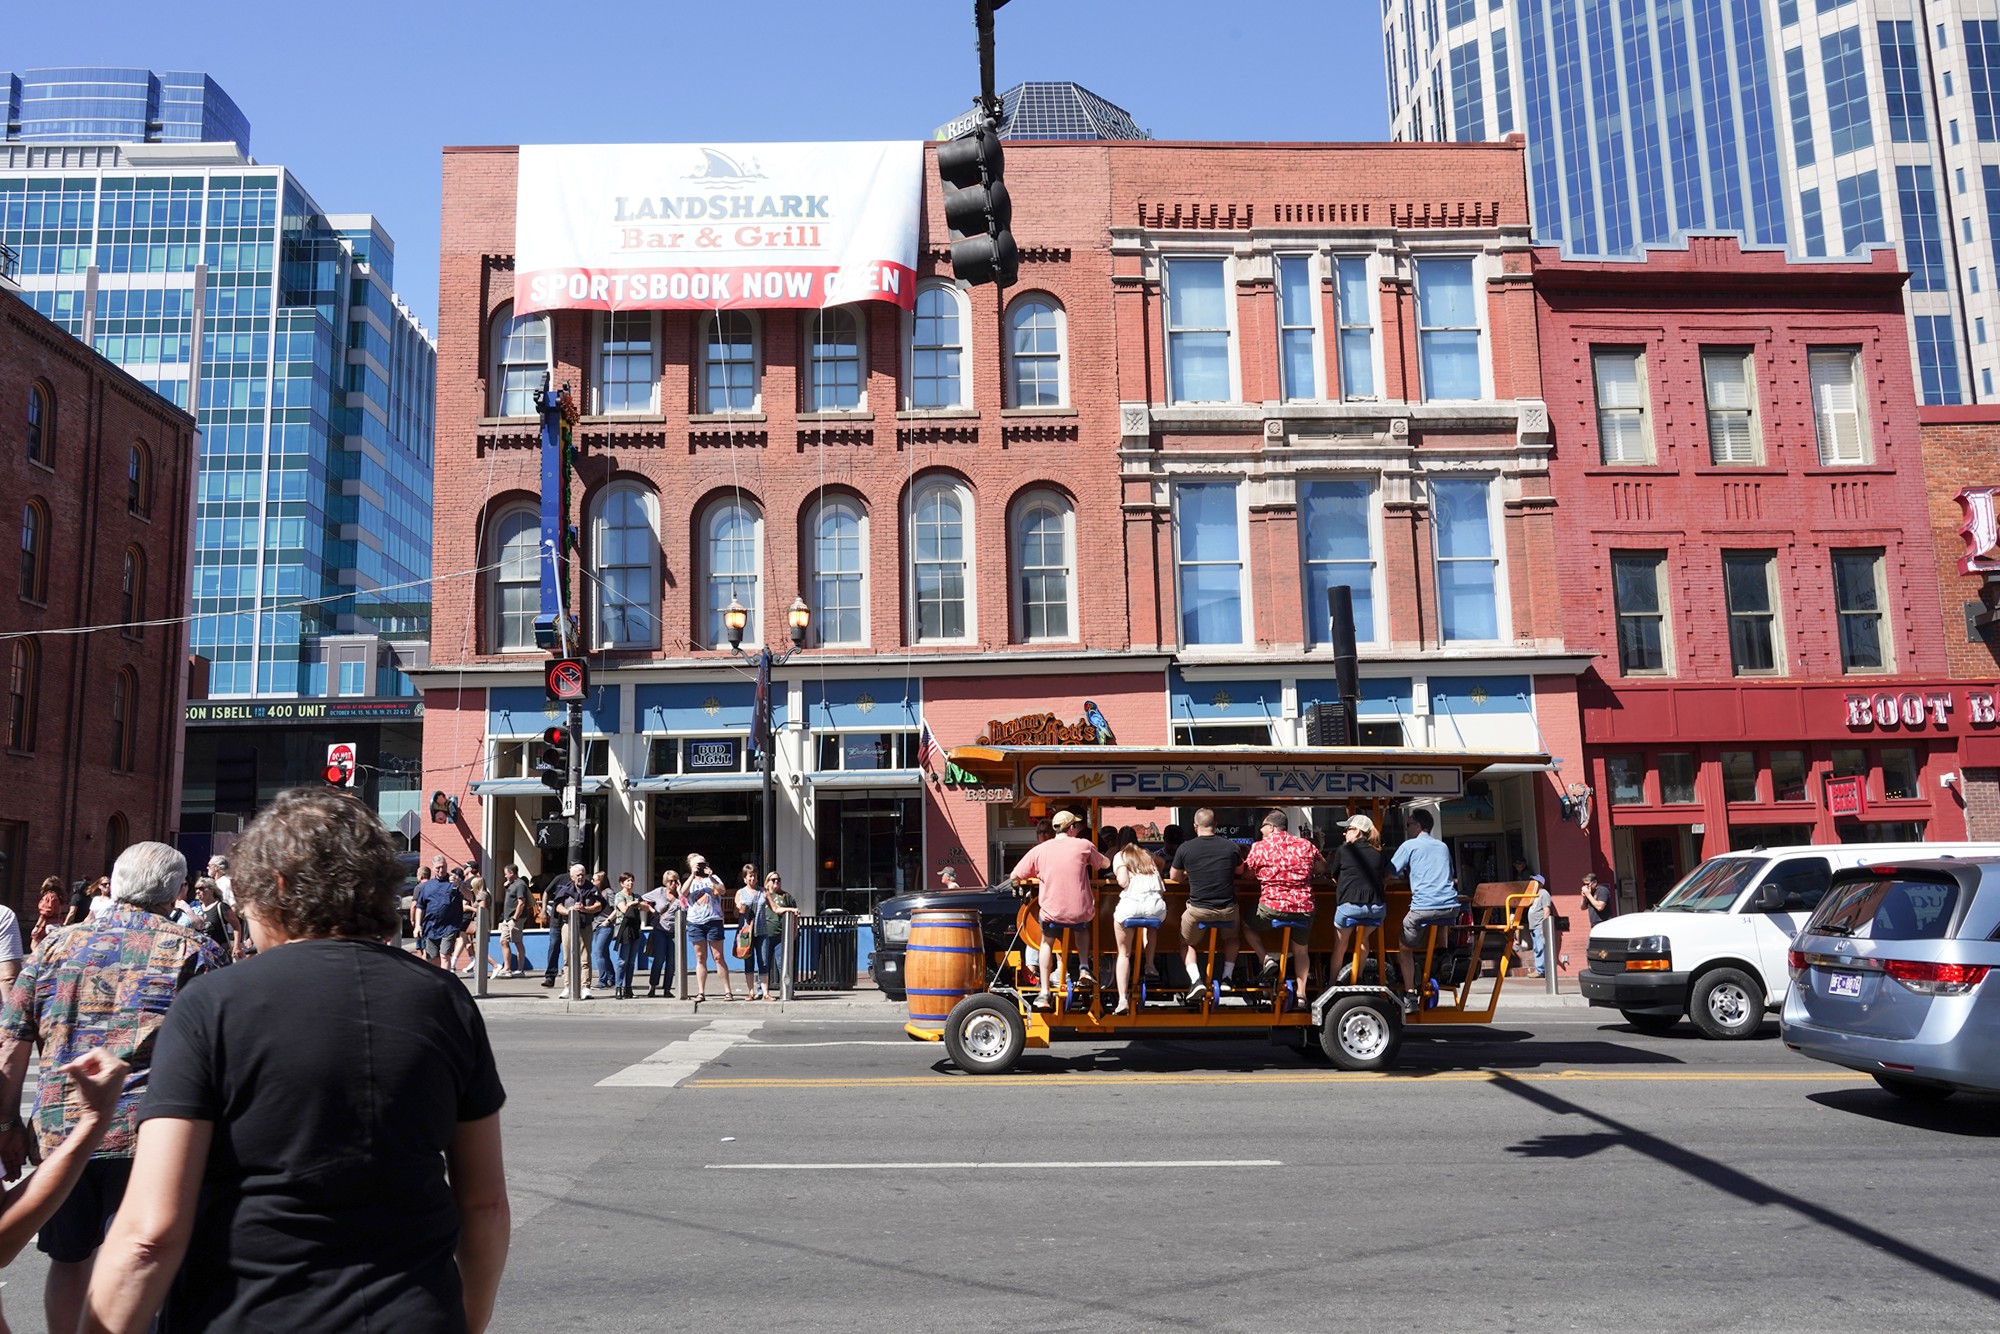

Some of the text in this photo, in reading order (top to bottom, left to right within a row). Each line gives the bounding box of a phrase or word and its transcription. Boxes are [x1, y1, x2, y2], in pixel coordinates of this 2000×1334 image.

[614, 195, 830, 222] LANDSHARK
[621, 226, 822, 250] Bar & Grill
[530, 273, 731, 303] SPORTSBOOK
[743, 272, 813, 299] NOW
[211, 706, 252, 719] ISBELL
[267, 705, 293, 717] 400
[298, 704, 327, 717] UNIT
[1845, 691, 2000, 726] BOOT B
[983, 712, 1055, 746] Jimmy
[694, 754, 731, 765] LIGHT
[699, 744, 725, 755] BUD
[1072, 773, 1105, 793] The
[1110, 773, 1241, 793] PEDAL
[1260, 772, 1395, 792] TAVERN
[949, 848, 964, 857] 322
